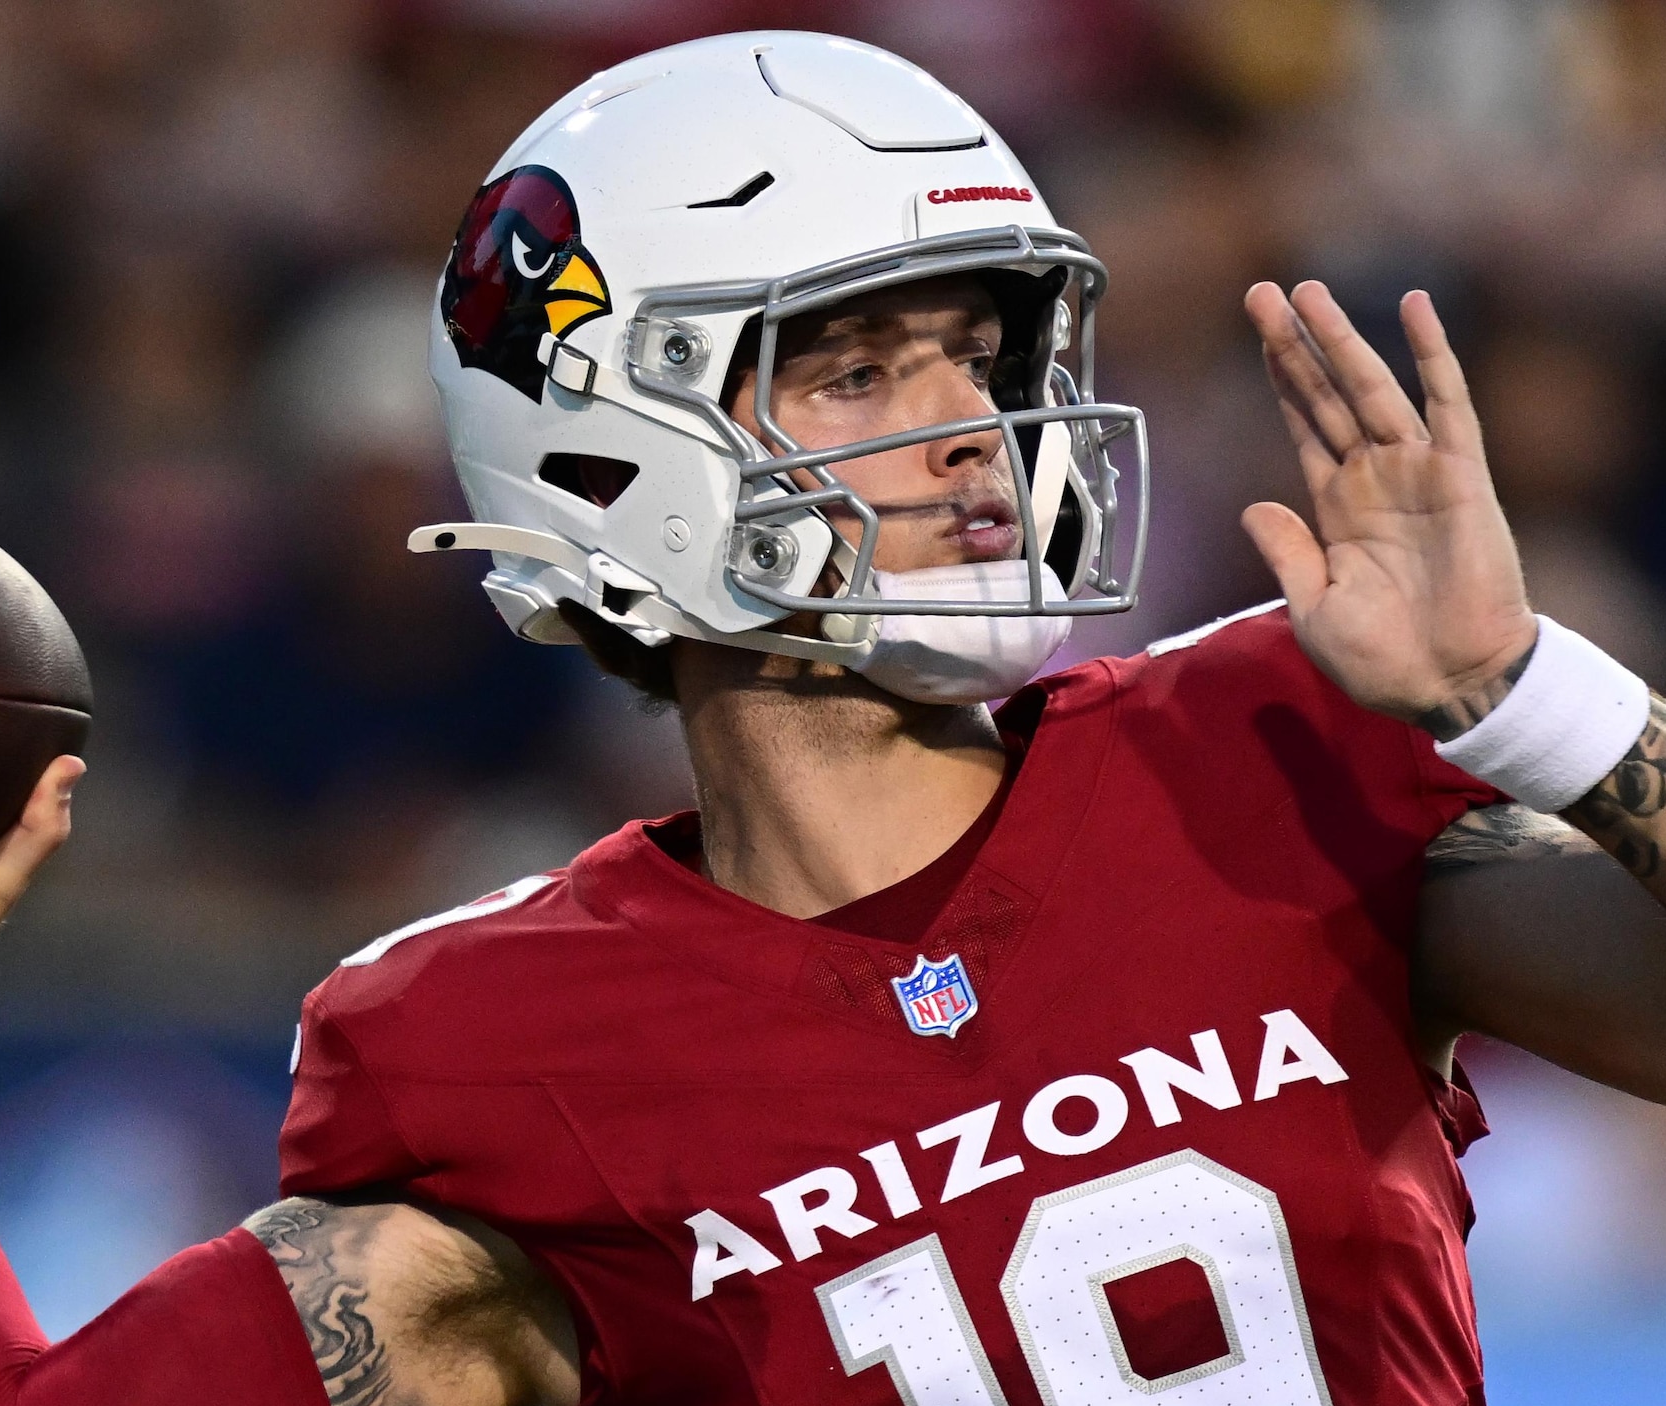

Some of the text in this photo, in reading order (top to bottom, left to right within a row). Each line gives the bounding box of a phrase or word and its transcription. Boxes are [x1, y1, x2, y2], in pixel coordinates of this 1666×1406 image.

[927, 186, 1033, 204] CARDINALS
[913, 987, 967, 1025] NFL
[684, 1009, 1349, 1302] ARIZONA
